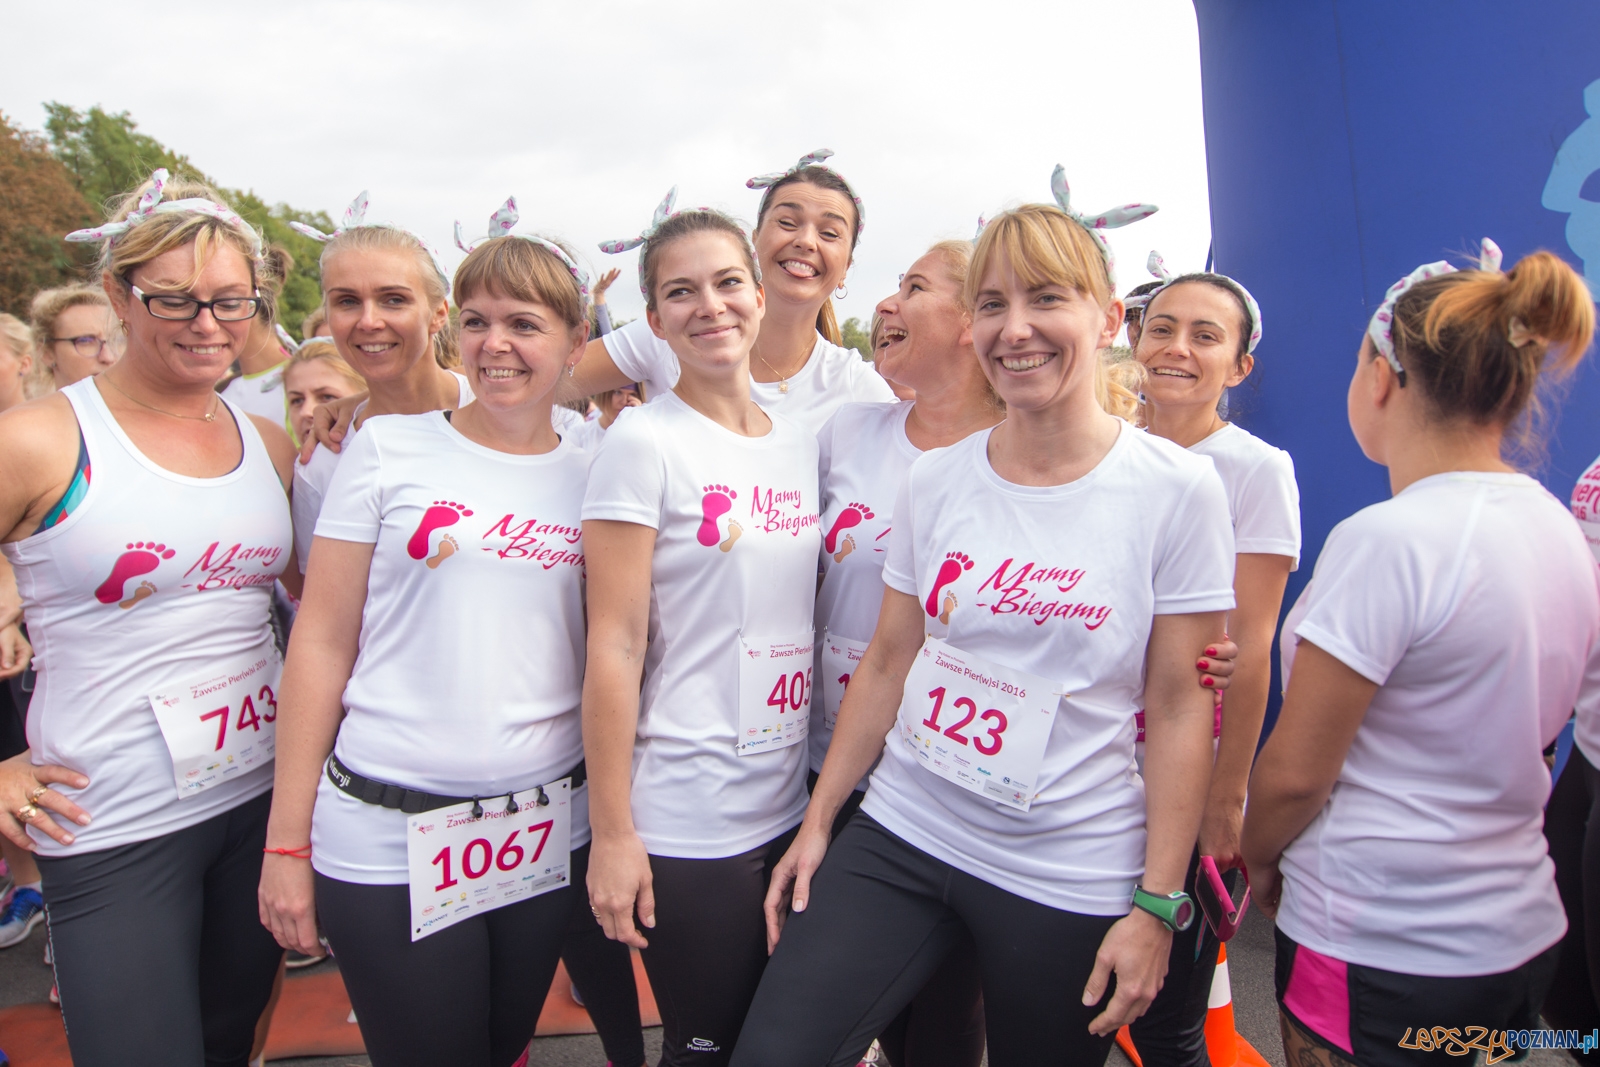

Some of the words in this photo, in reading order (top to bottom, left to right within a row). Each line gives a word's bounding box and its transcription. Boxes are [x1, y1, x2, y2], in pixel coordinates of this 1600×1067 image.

[750, 485, 801, 518] Mamy
[482, 513, 583, 545] Mamy
[183, 541, 283, 579] Mamy
[977, 558, 1087, 595] Mamy
[770, 649, 794, 658] Zawsze
[192, 681, 228, 699] Zawsze
[767, 666, 813, 714] 405
[935, 656, 963, 675] Zawsze
[964, 667, 1000, 688] Pier(w)si
[1001, 682, 1026, 698] 2016
[199, 684, 278, 752] 743
[922, 686, 1008, 757] 123
[431, 819, 554, 893] 1067
